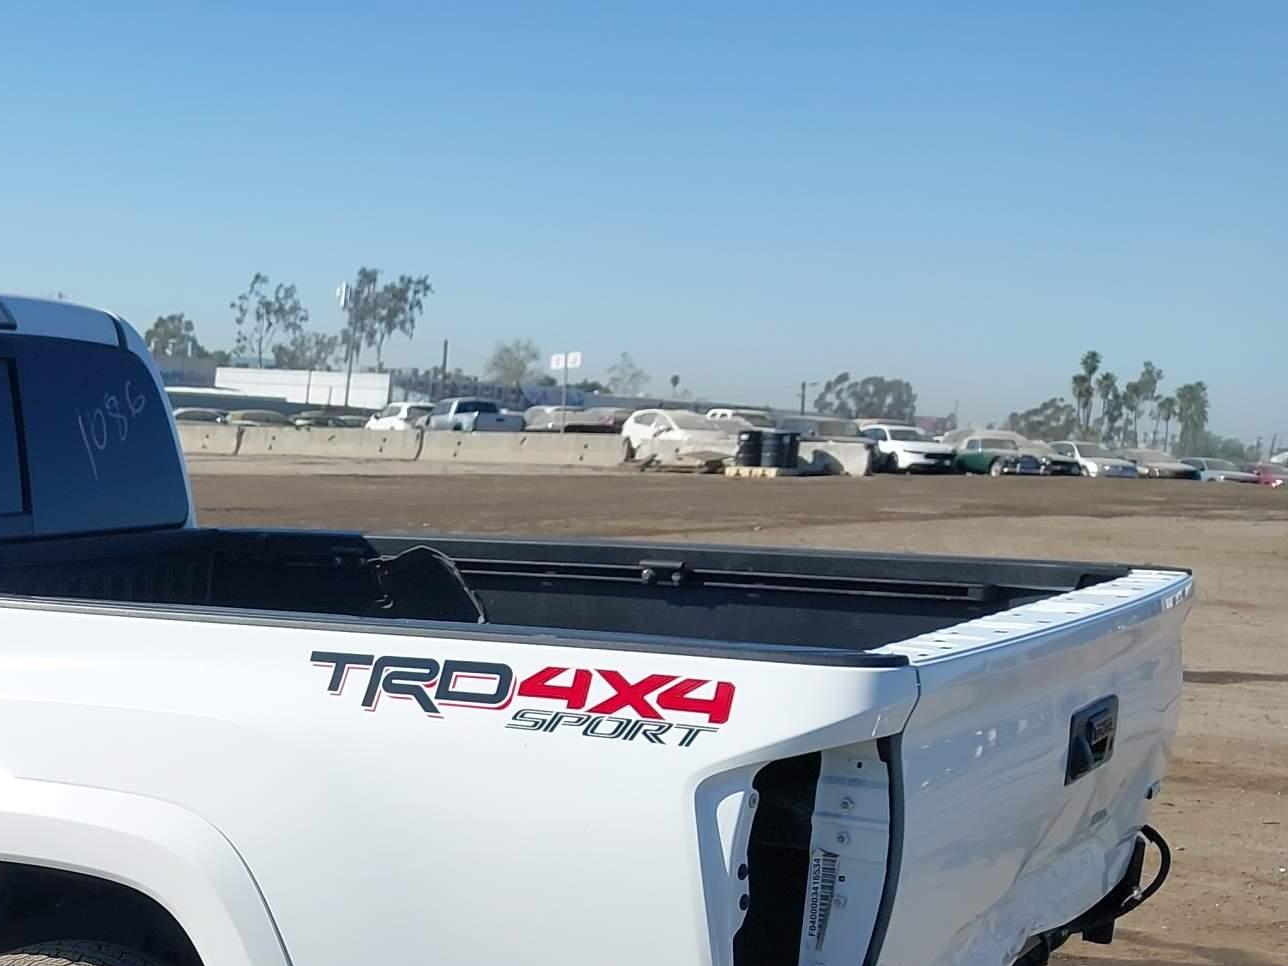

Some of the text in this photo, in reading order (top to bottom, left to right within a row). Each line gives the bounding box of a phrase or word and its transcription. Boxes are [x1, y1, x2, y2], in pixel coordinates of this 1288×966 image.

[77, 380, 147, 481] 1086
[310, 651, 516, 719] TRD
[505, 709, 719, 747] SPORT
